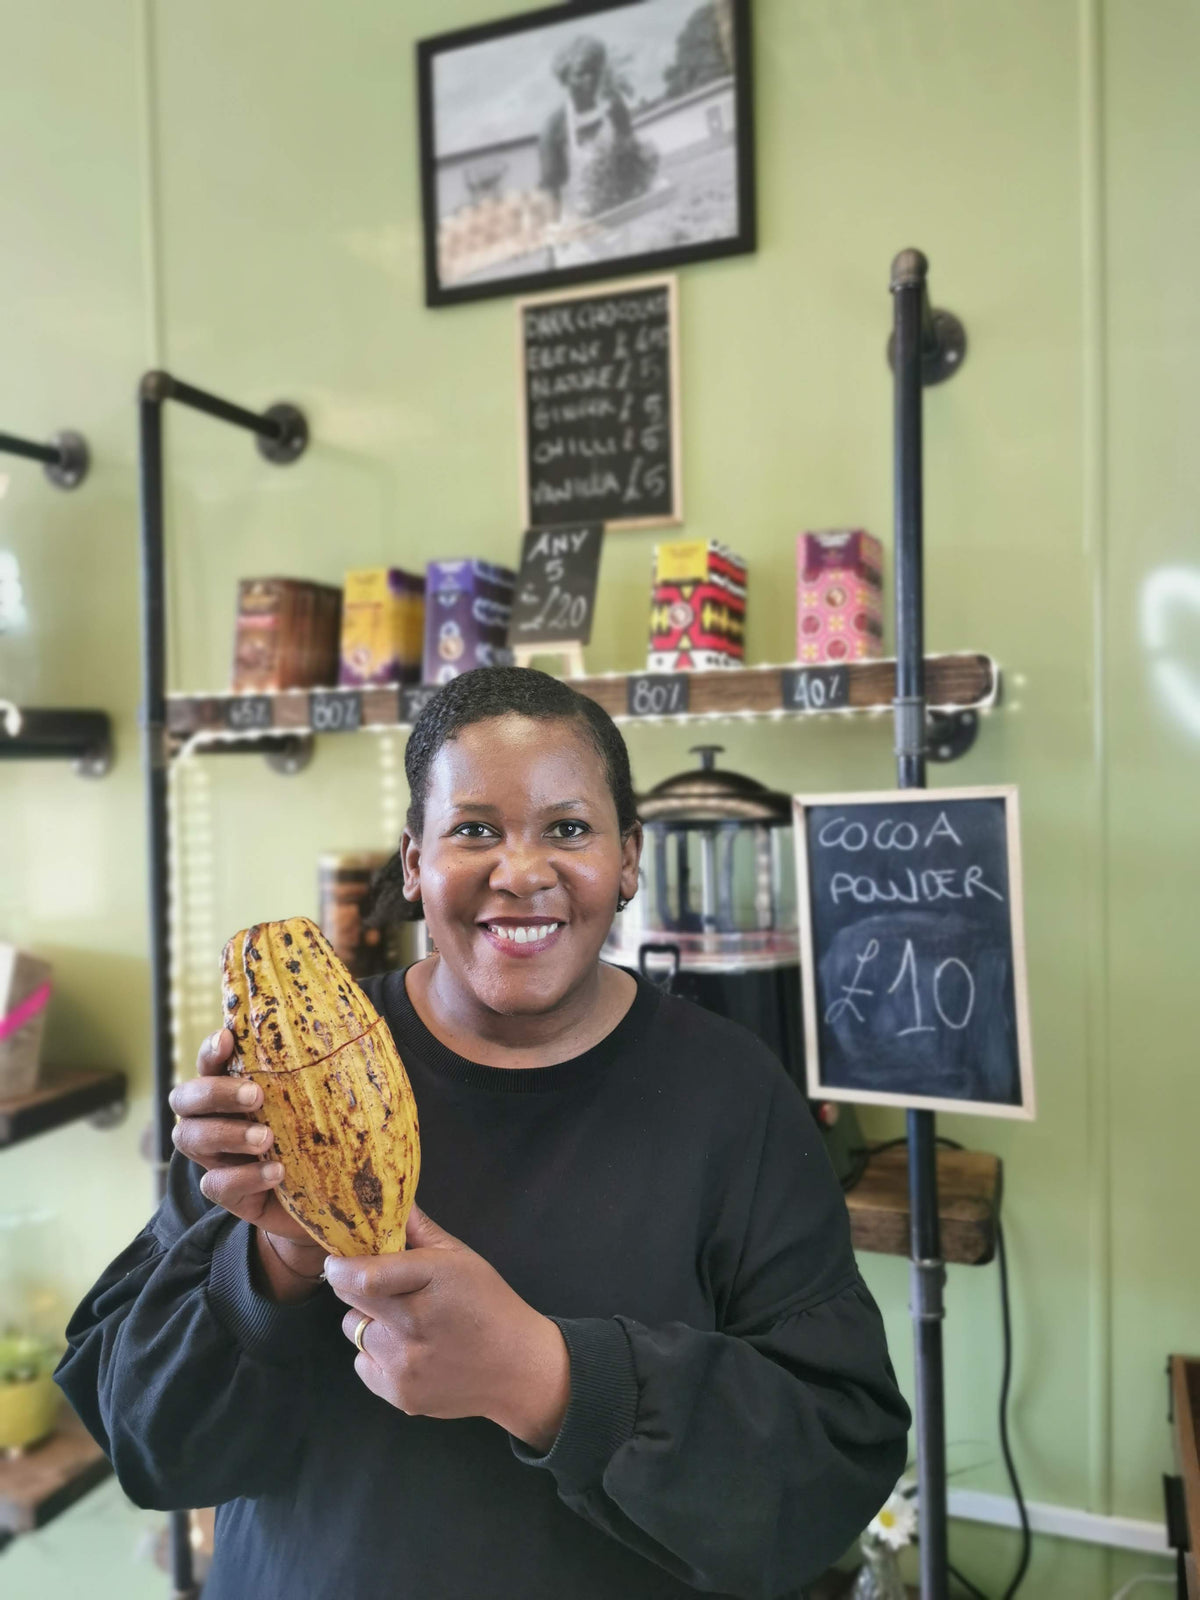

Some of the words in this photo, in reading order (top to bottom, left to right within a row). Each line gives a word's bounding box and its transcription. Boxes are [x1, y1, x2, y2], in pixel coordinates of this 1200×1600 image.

[534, 436, 616, 464] CHILLI
[527, 529, 588, 561] ANY
[545, 558, 565, 582] 5
[632, 679, 681, 713] 80%
[794, 672, 842, 709] 40%
[818, 811, 963, 851] COCOA
[829, 864, 1004, 904] POWDER
[824, 938, 975, 1036] £10
